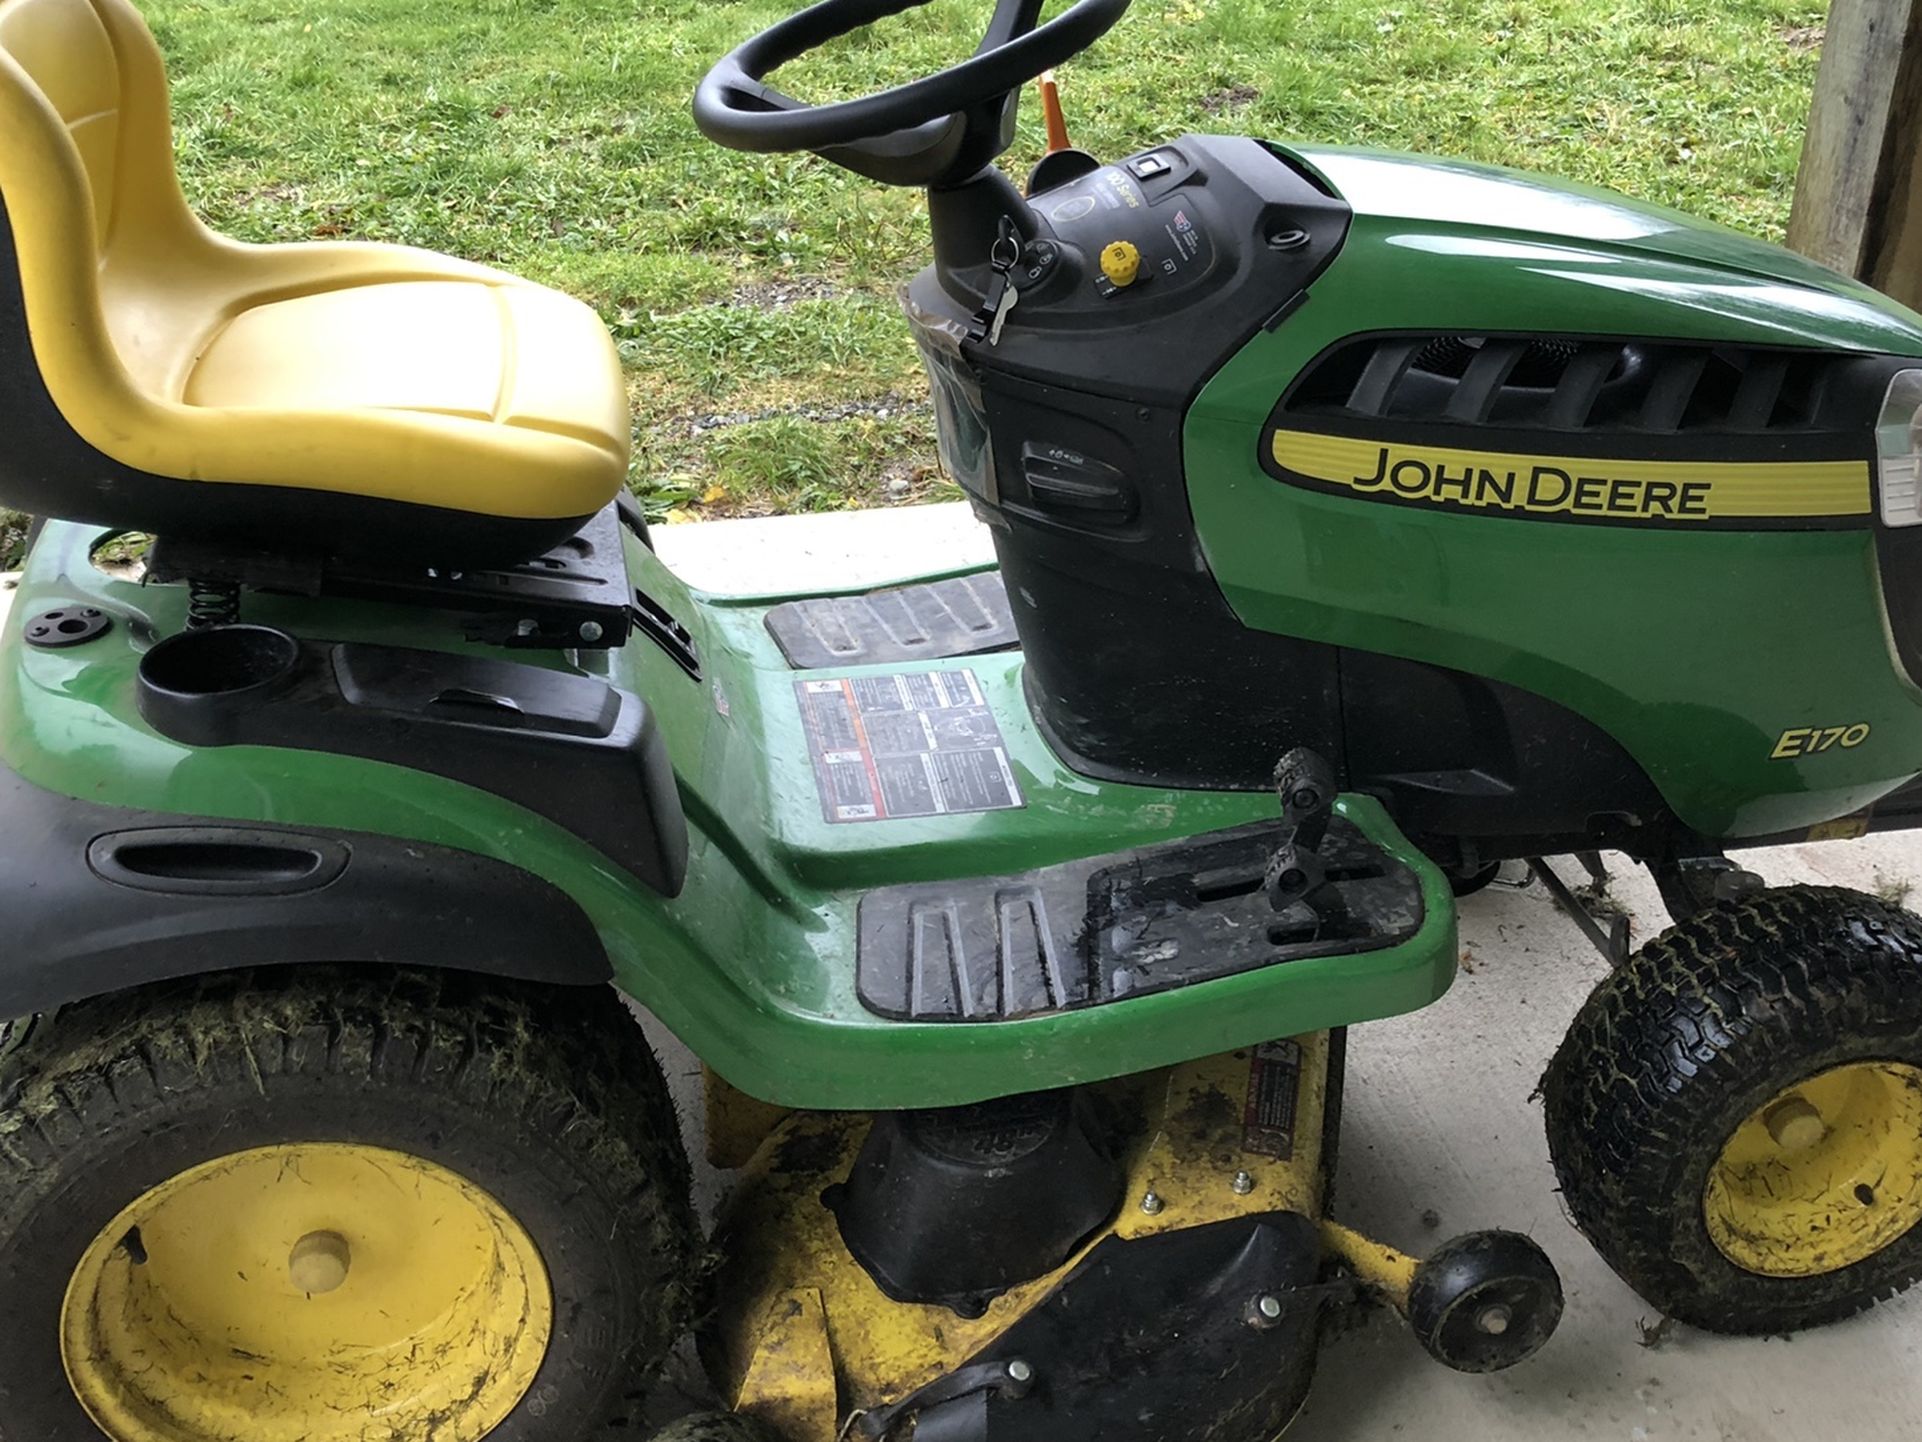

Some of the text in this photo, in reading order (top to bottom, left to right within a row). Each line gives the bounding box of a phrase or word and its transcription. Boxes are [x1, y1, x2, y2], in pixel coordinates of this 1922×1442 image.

[1353, 448, 1712, 515] JOHN DEERE
[1769, 722, 1871, 759] E170
